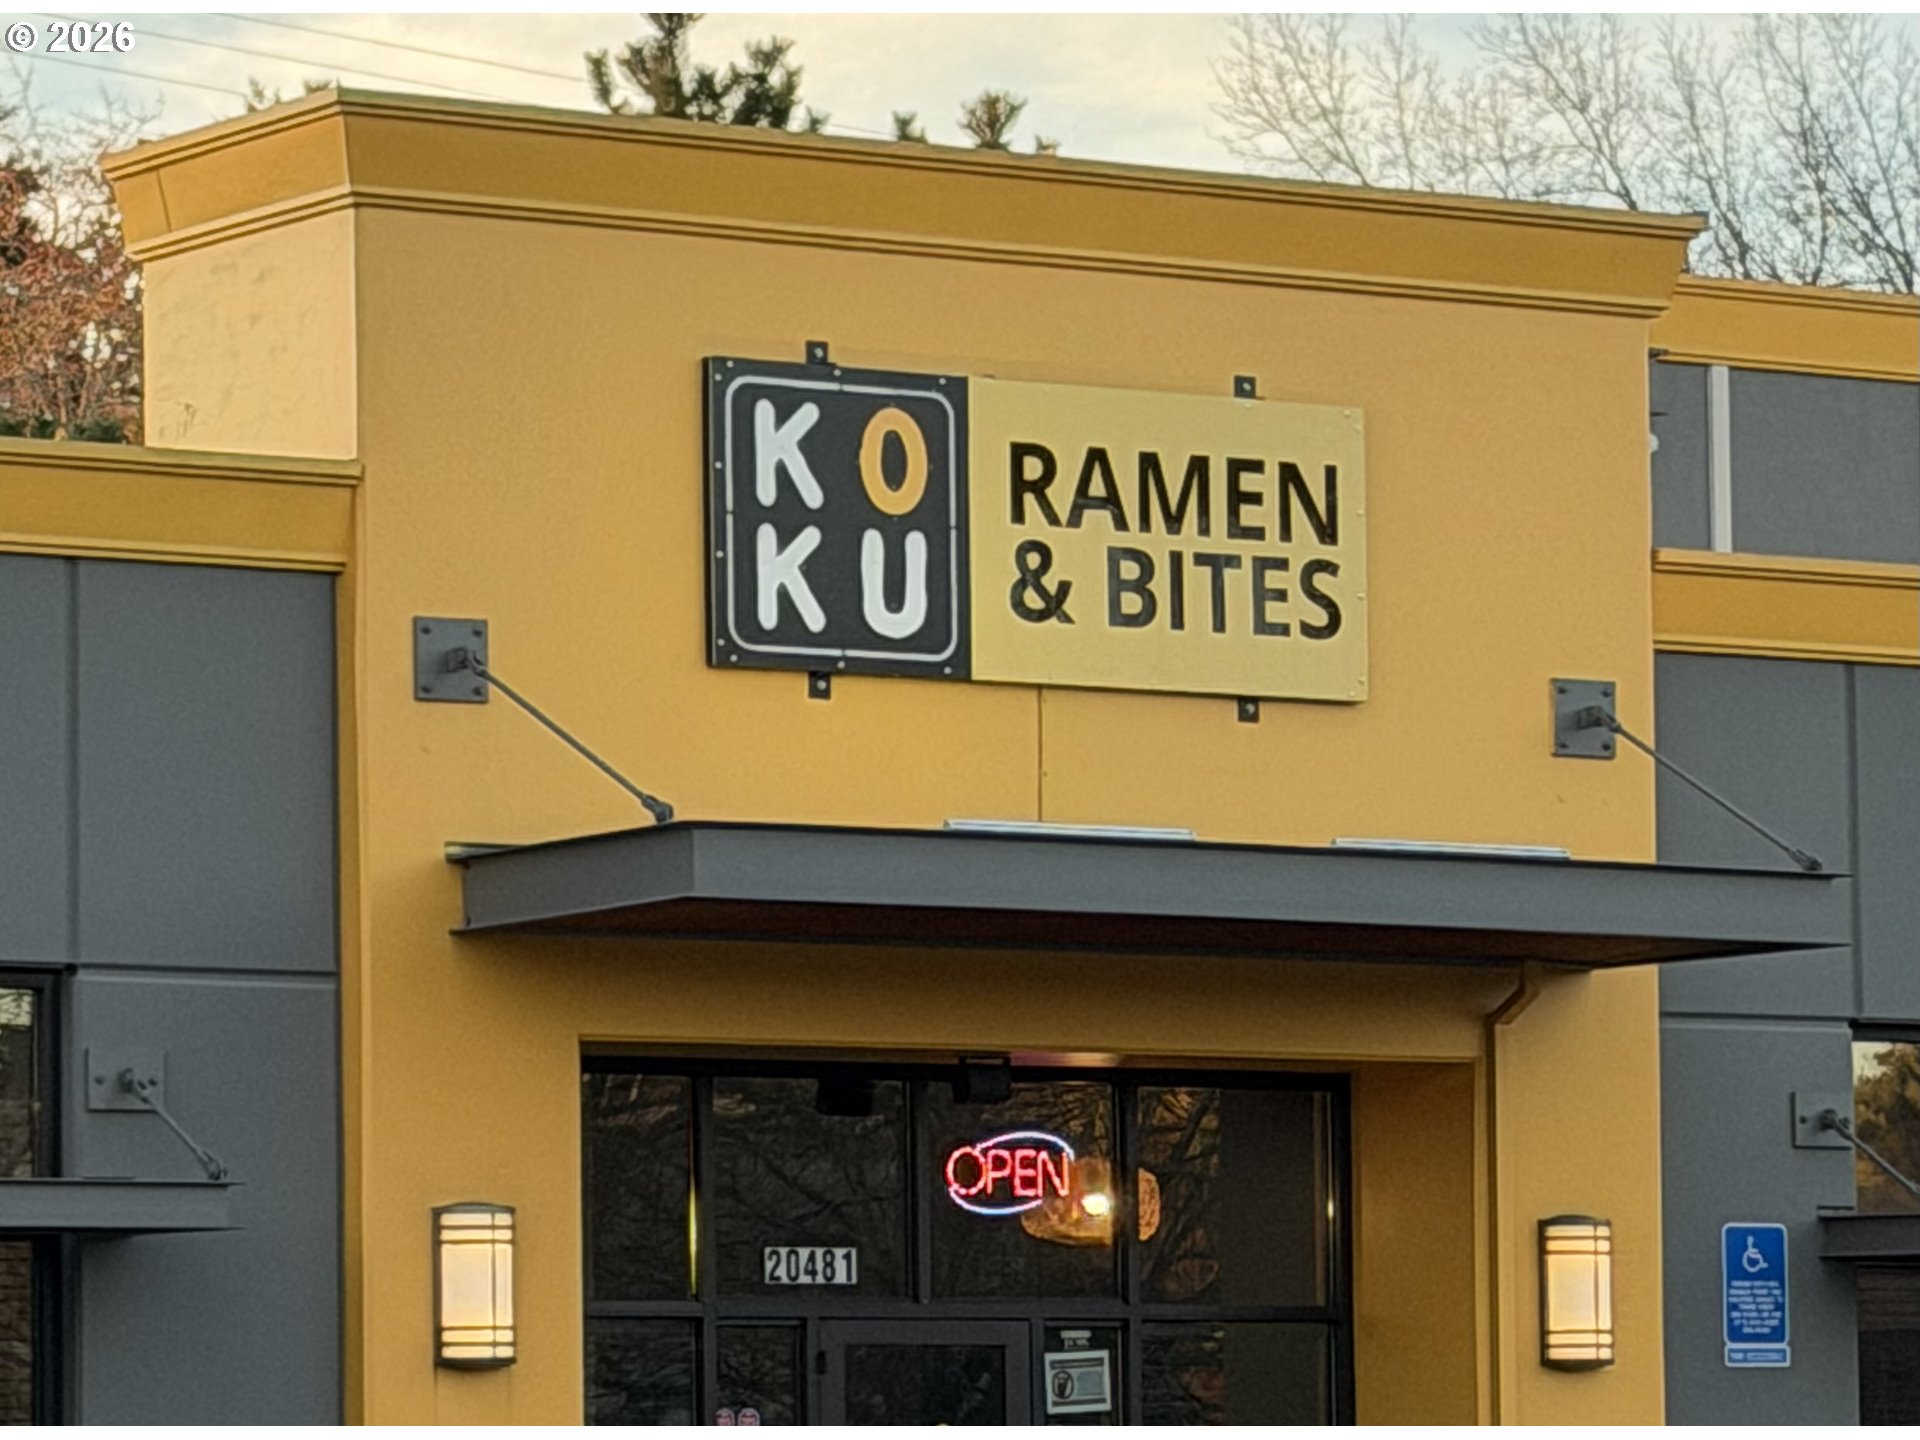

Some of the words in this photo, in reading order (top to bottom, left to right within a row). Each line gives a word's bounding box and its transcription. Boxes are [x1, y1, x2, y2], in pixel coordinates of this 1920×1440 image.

[1009, 441, 1338, 546] RAMEN
[1010, 539, 1076, 625] &
[1107, 546, 1342, 640] BITES
[946, 1146, 1070, 1197] OPEN
[767, 1248, 854, 1283] 20481
